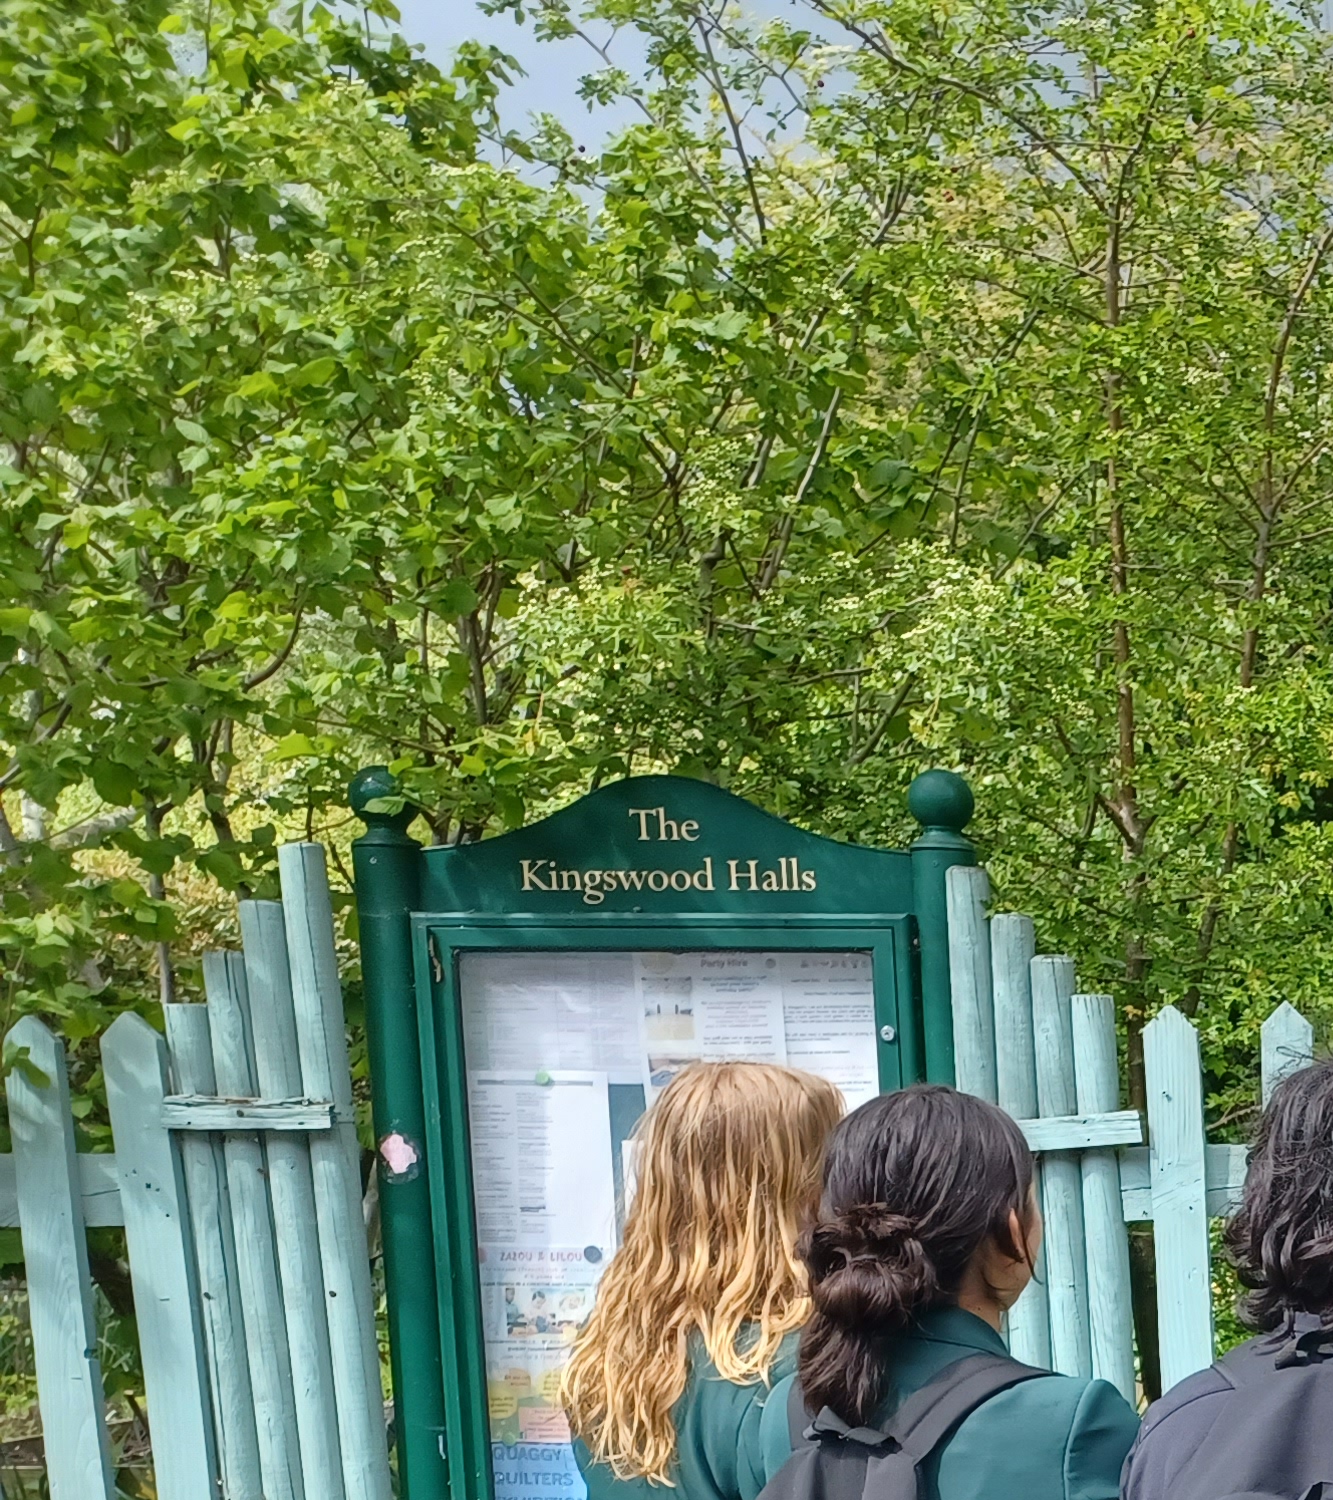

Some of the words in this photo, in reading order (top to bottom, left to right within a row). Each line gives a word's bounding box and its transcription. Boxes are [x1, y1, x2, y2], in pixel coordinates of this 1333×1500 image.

[628, 806, 700, 842] The
[519, 857, 716, 905] Kingswood
[726, 857, 817, 892] Halls
[494, 1446, 561, 1462] QUAGGY
[495, 1471, 574, 1487] QUILTERS
